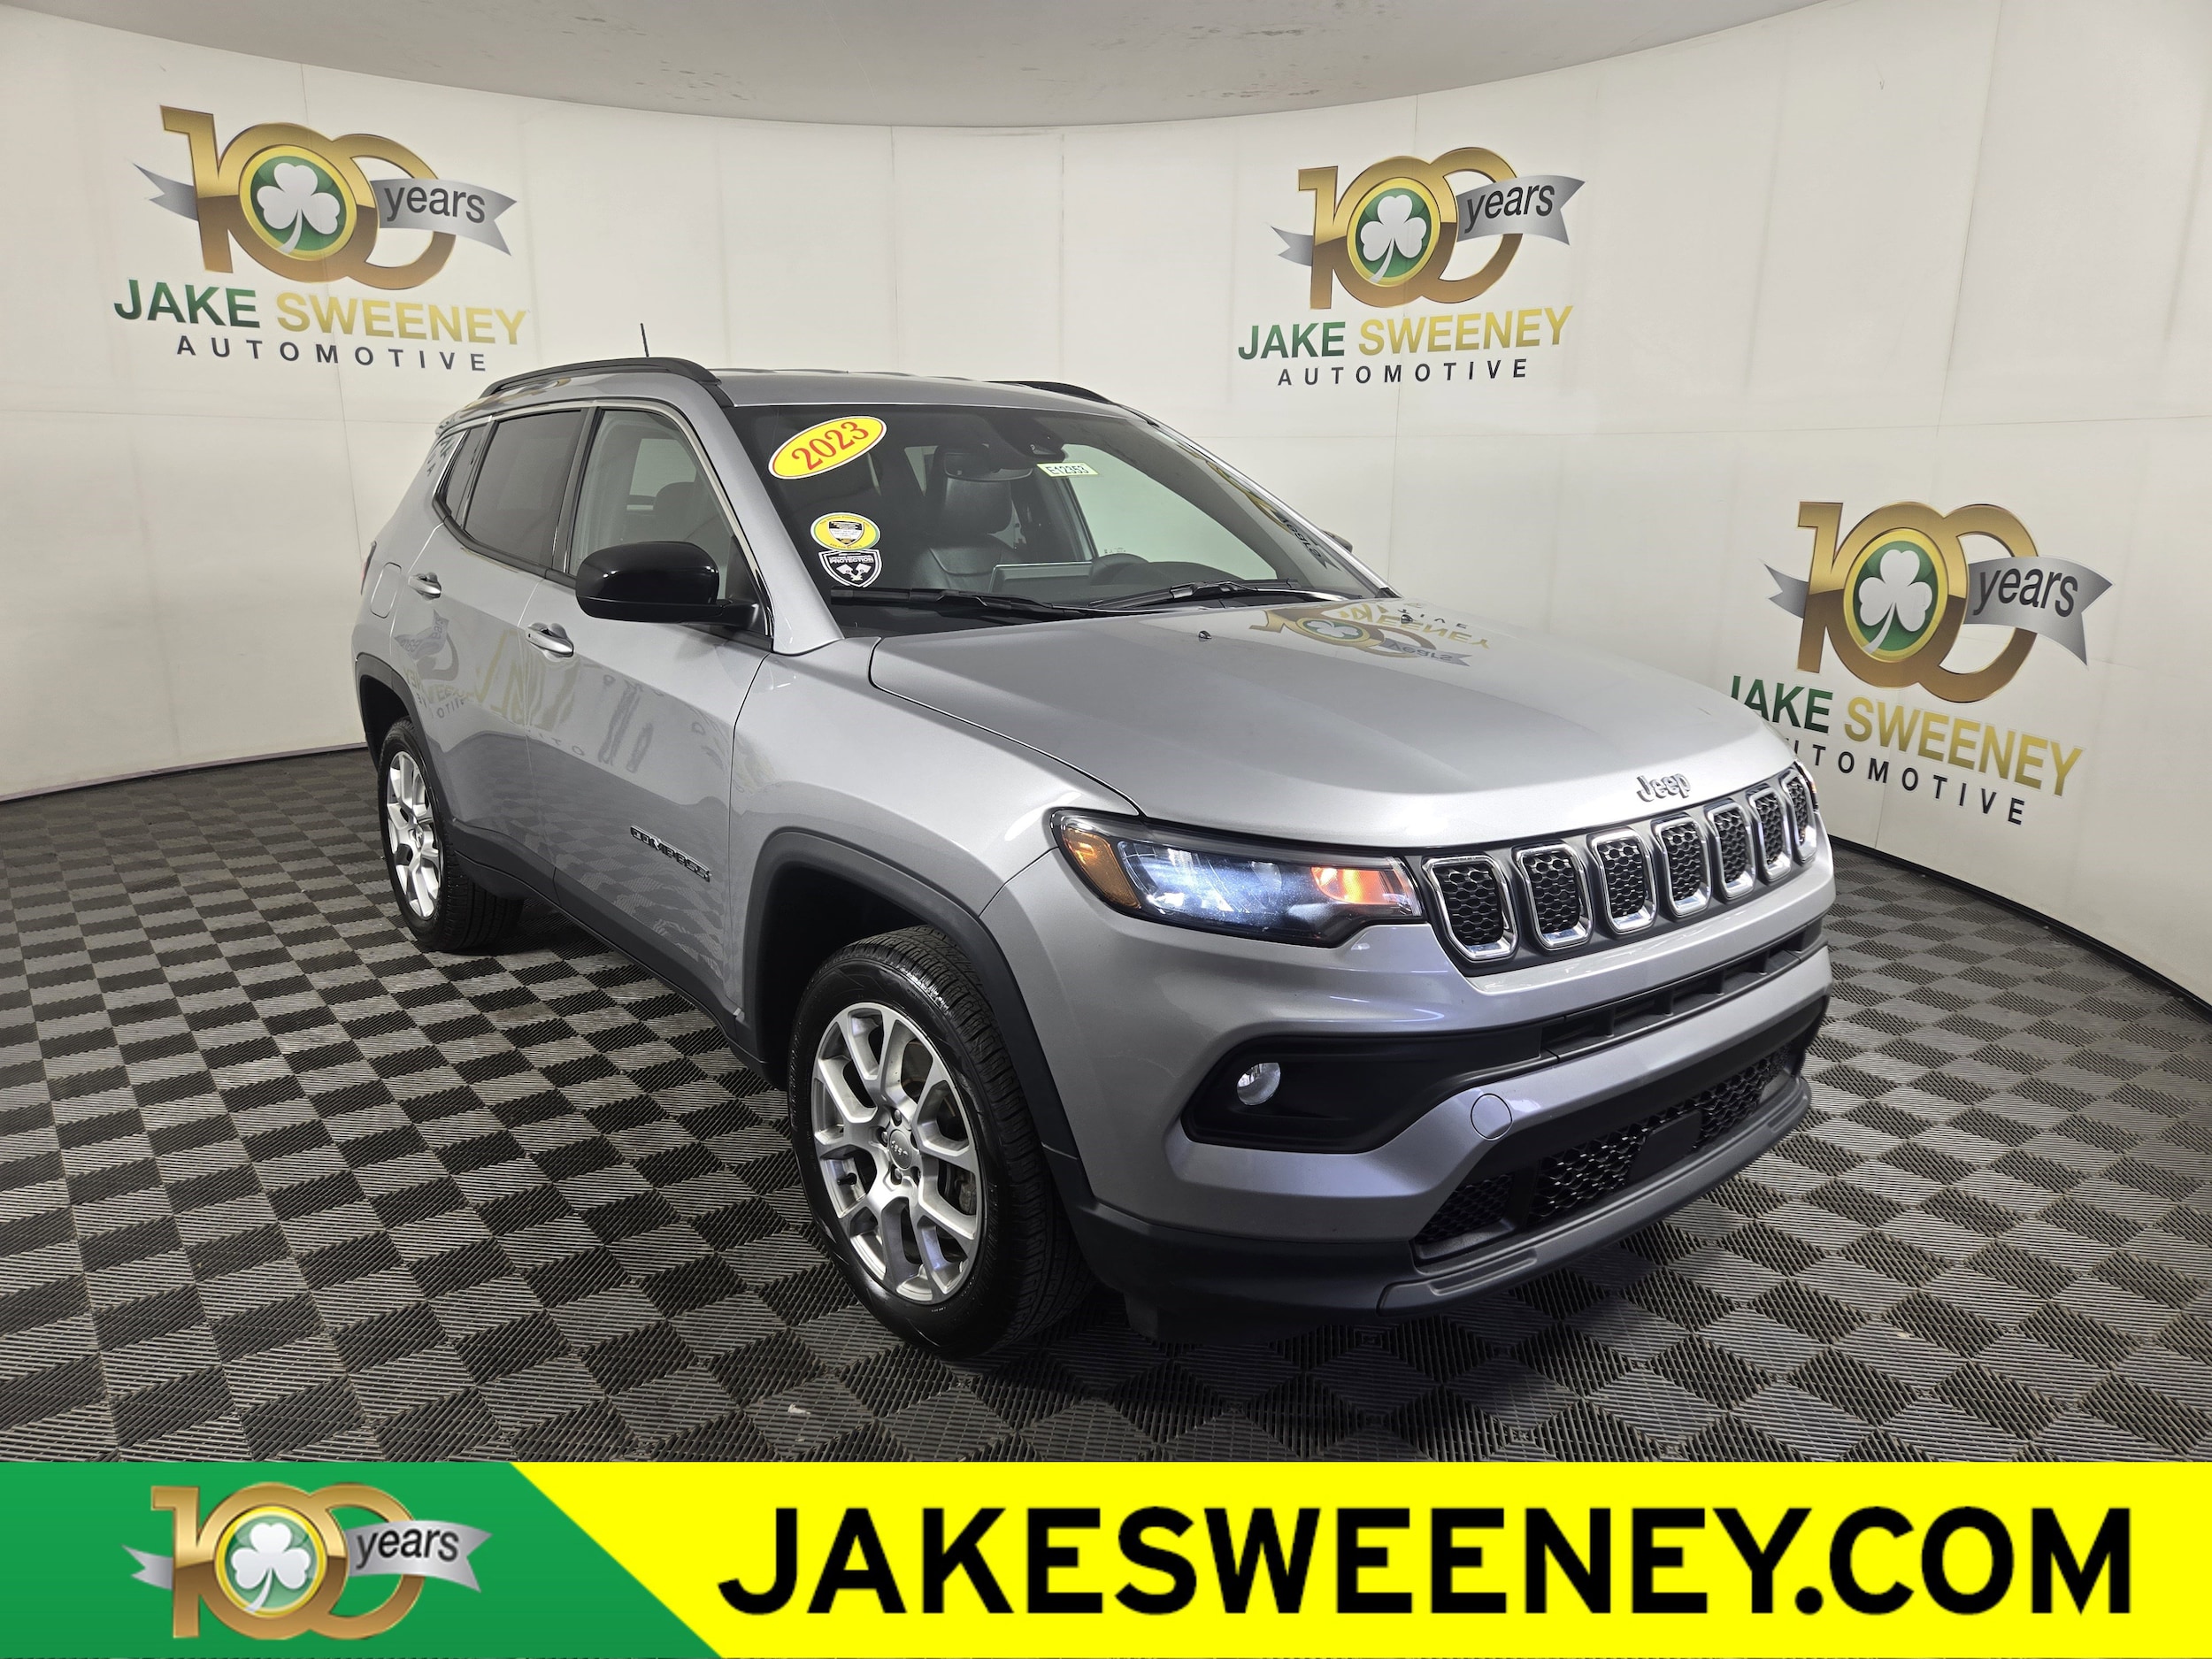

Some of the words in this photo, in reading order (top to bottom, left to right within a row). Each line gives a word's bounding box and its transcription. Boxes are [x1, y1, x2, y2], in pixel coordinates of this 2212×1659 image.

[160, 104, 456, 290] 100
[384, 183, 486, 223] years
[1298, 147, 1523, 309] 100
[1464, 183, 1555, 234] years
[113, 279, 261, 329] JAKE
[276, 292, 526, 346] SWEENEY
[1239, 321, 1346, 360] JAKE
[1359, 305, 1573, 356] SWEENEY
[177, 335, 487, 372] AUTOMOTIVE
[1278, 358, 1527, 386] AUTOMOTIVE
[792, 420, 870, 470] 2023
[1797, 502, 2040, 703] 100
[1973, 567, 2078, 618] years
[1844, 697, 2083, 796] SWEENEY
[1636, 772, 1691, 803] Jeep
[1786, 738, 2025, 826] TOMOTIVE
